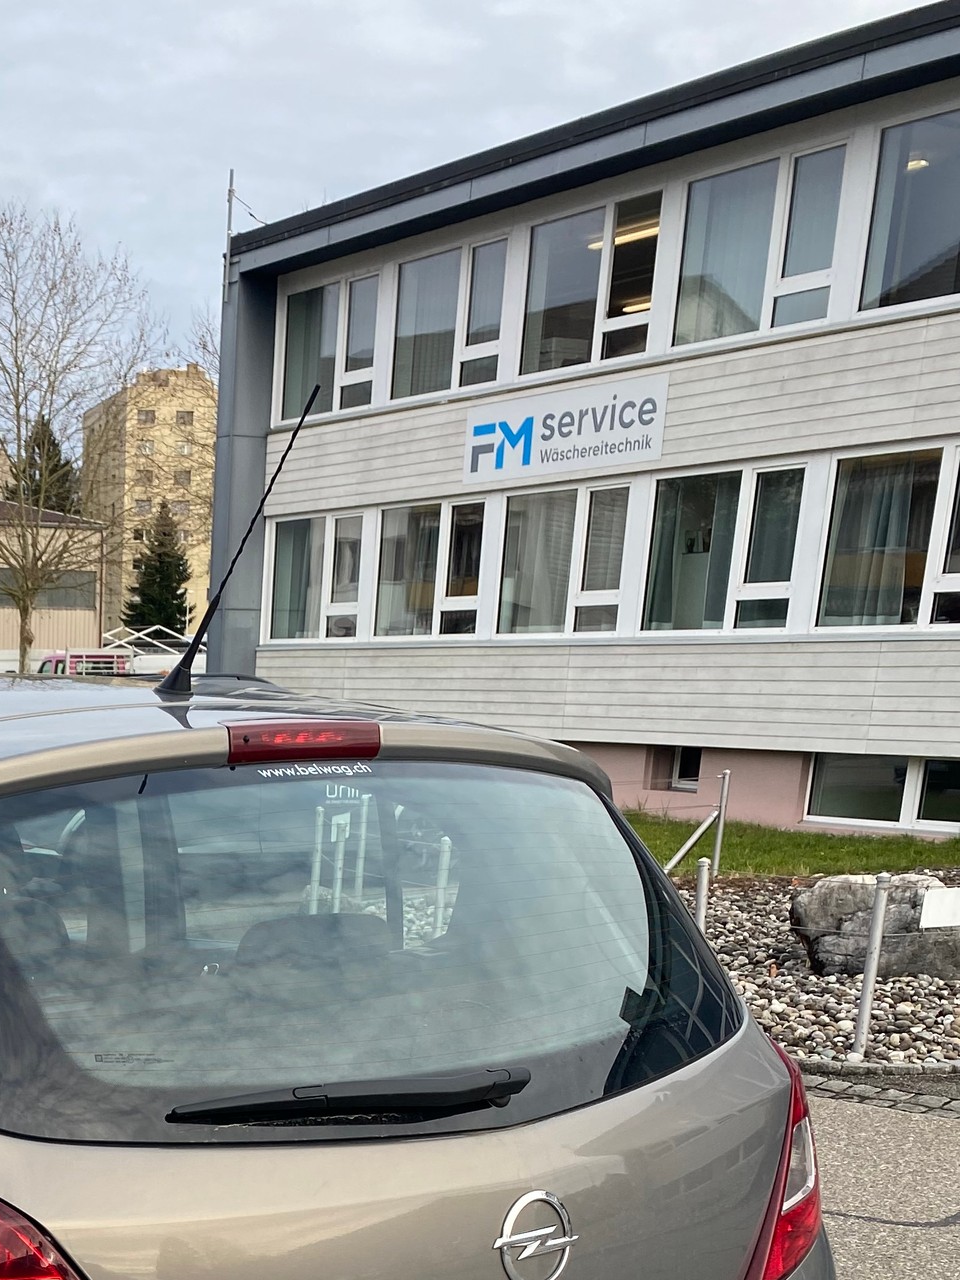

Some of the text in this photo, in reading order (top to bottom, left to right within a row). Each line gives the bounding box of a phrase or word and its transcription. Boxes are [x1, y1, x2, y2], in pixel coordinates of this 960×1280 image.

[470, 394, 657, 473] FM service
[540, 434, 652, 464] Wäschereitechnik
[257, 761, 372, 778] www.belwag.ch
